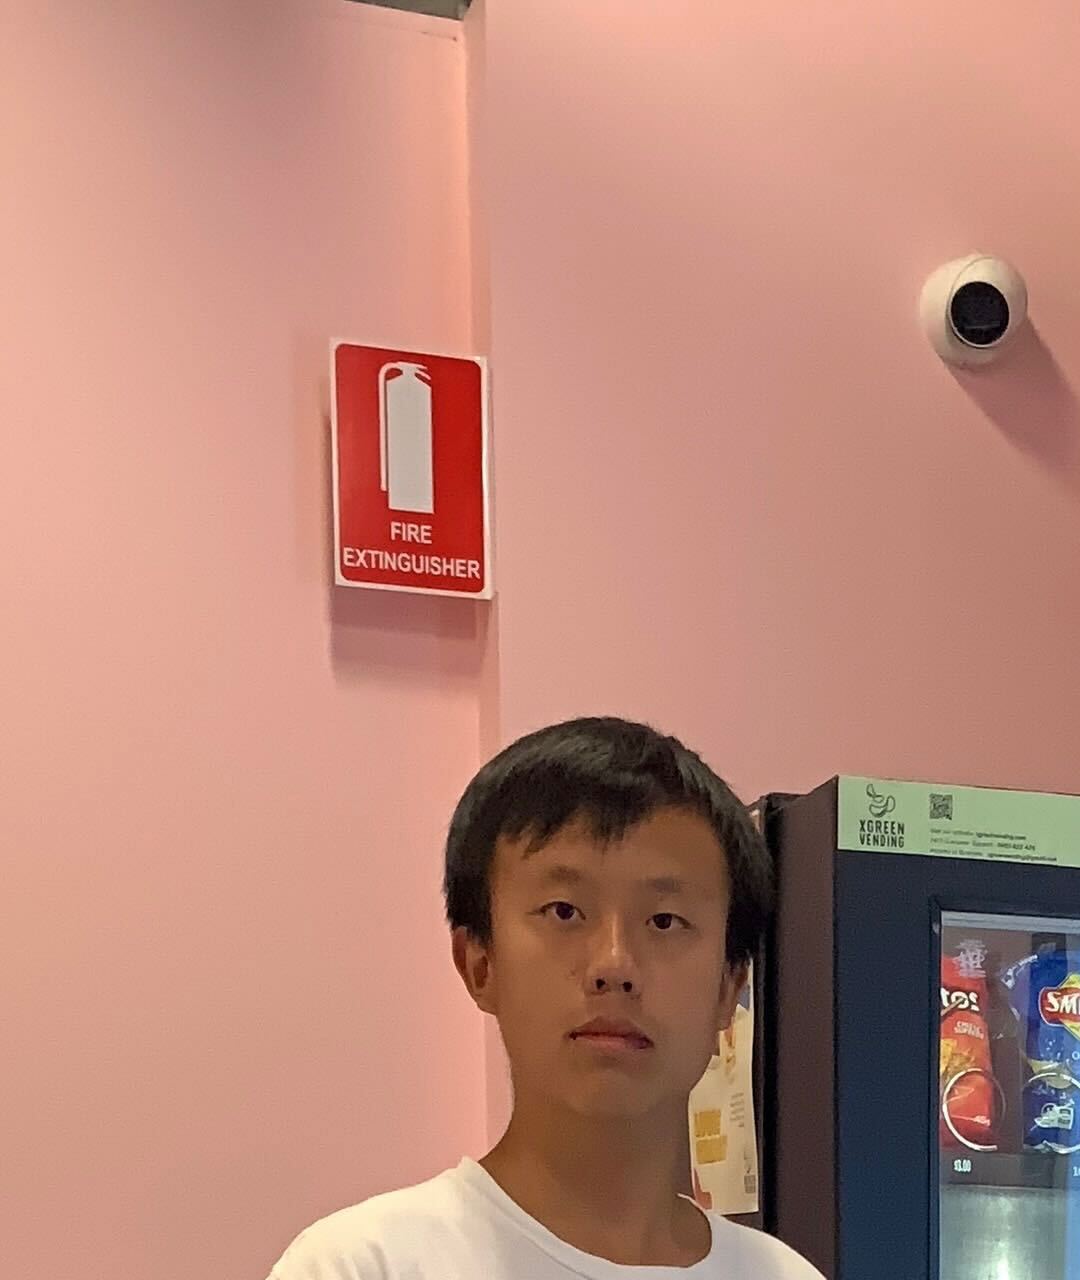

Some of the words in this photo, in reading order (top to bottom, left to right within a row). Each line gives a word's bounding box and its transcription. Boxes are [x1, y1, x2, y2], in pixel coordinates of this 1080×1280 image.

[390, 522, 432, 543] FIRE
[344, 547, 480, 579] EXTINGUISHER
[859, 819, 905, 835] XGREEN
[859, 832, 905, 848] VENDING
